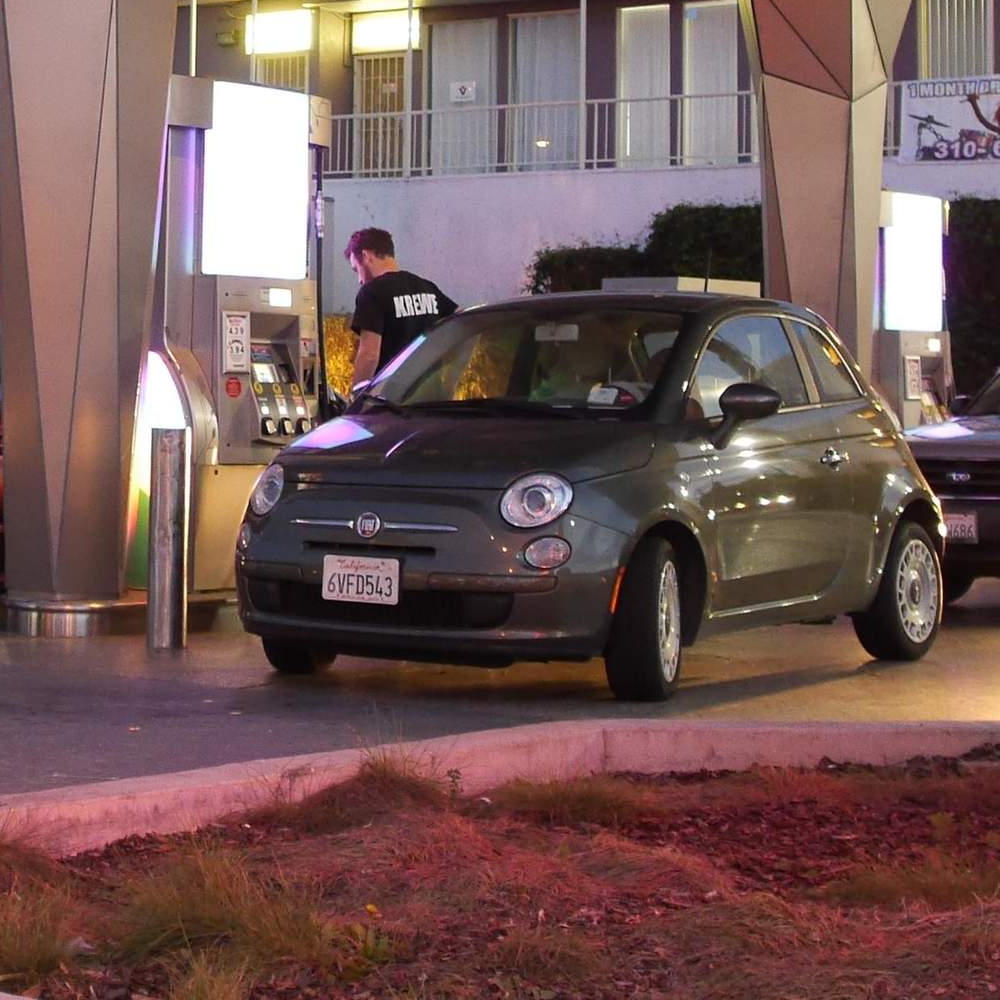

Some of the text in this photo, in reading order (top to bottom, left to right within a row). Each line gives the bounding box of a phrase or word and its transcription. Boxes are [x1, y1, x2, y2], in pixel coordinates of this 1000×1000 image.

[908, 83, 917, 98] 1
[919, 81, 976, 98] MONTH
[327, 572, 393, 597] 6VFD543
